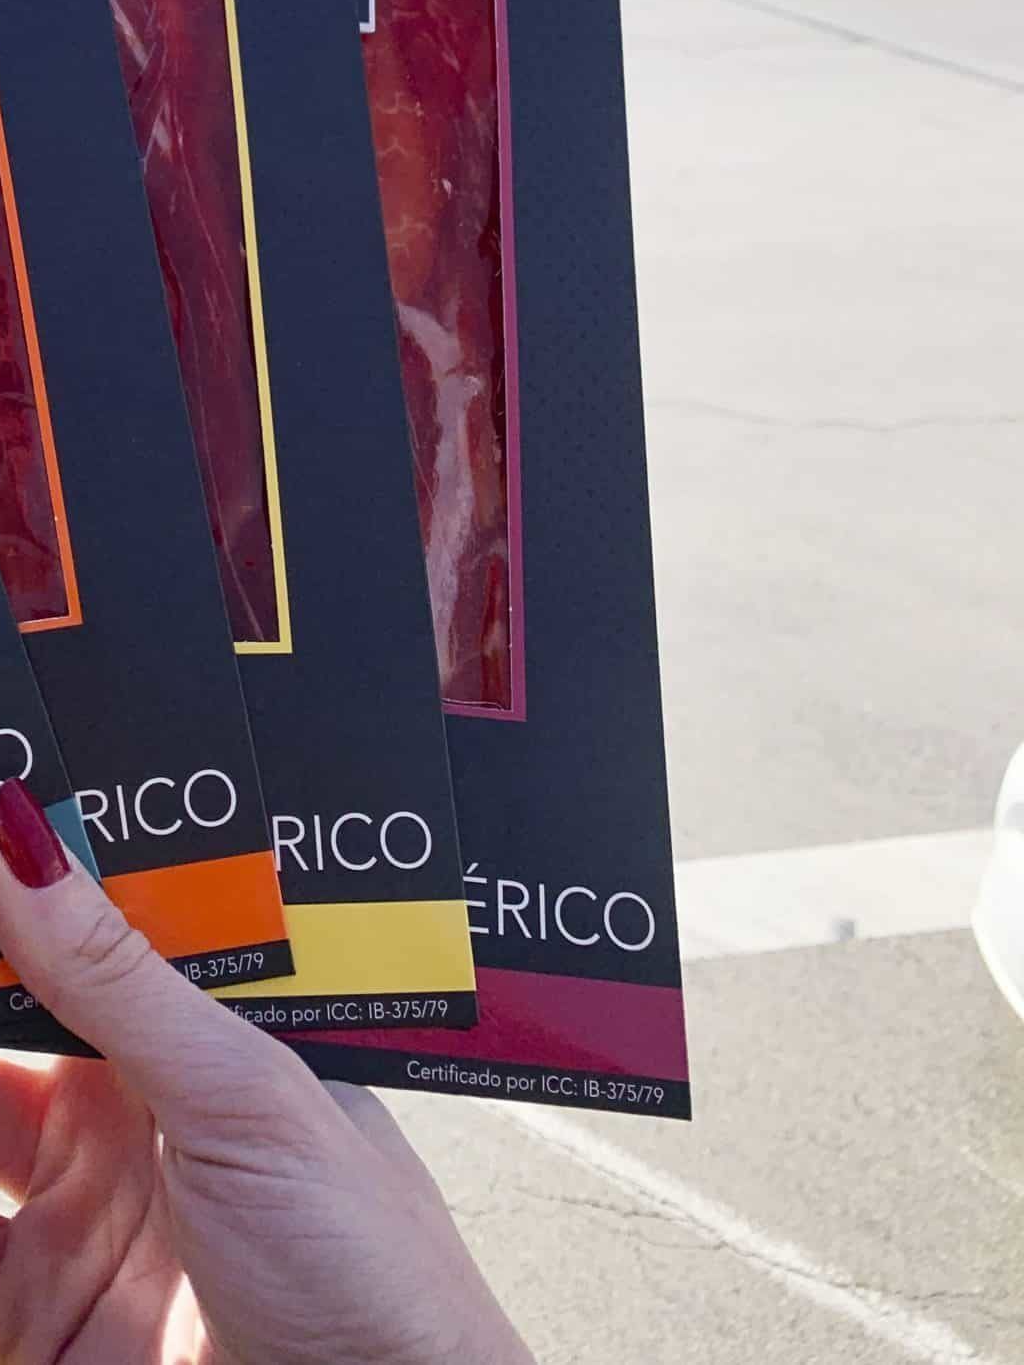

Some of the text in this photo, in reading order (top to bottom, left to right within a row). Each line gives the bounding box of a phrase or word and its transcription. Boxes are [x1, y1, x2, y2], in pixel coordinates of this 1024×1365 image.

[184, 952, 264, 980] IB-375/79
[292, 1008, 320, 1026] por
[327, 1002, 362, 1021] ICC:
[368, 999, 448, 1020] IB-375/79
[407, 1060, 664, 1105] Certificado por ICC: IB-375/79
